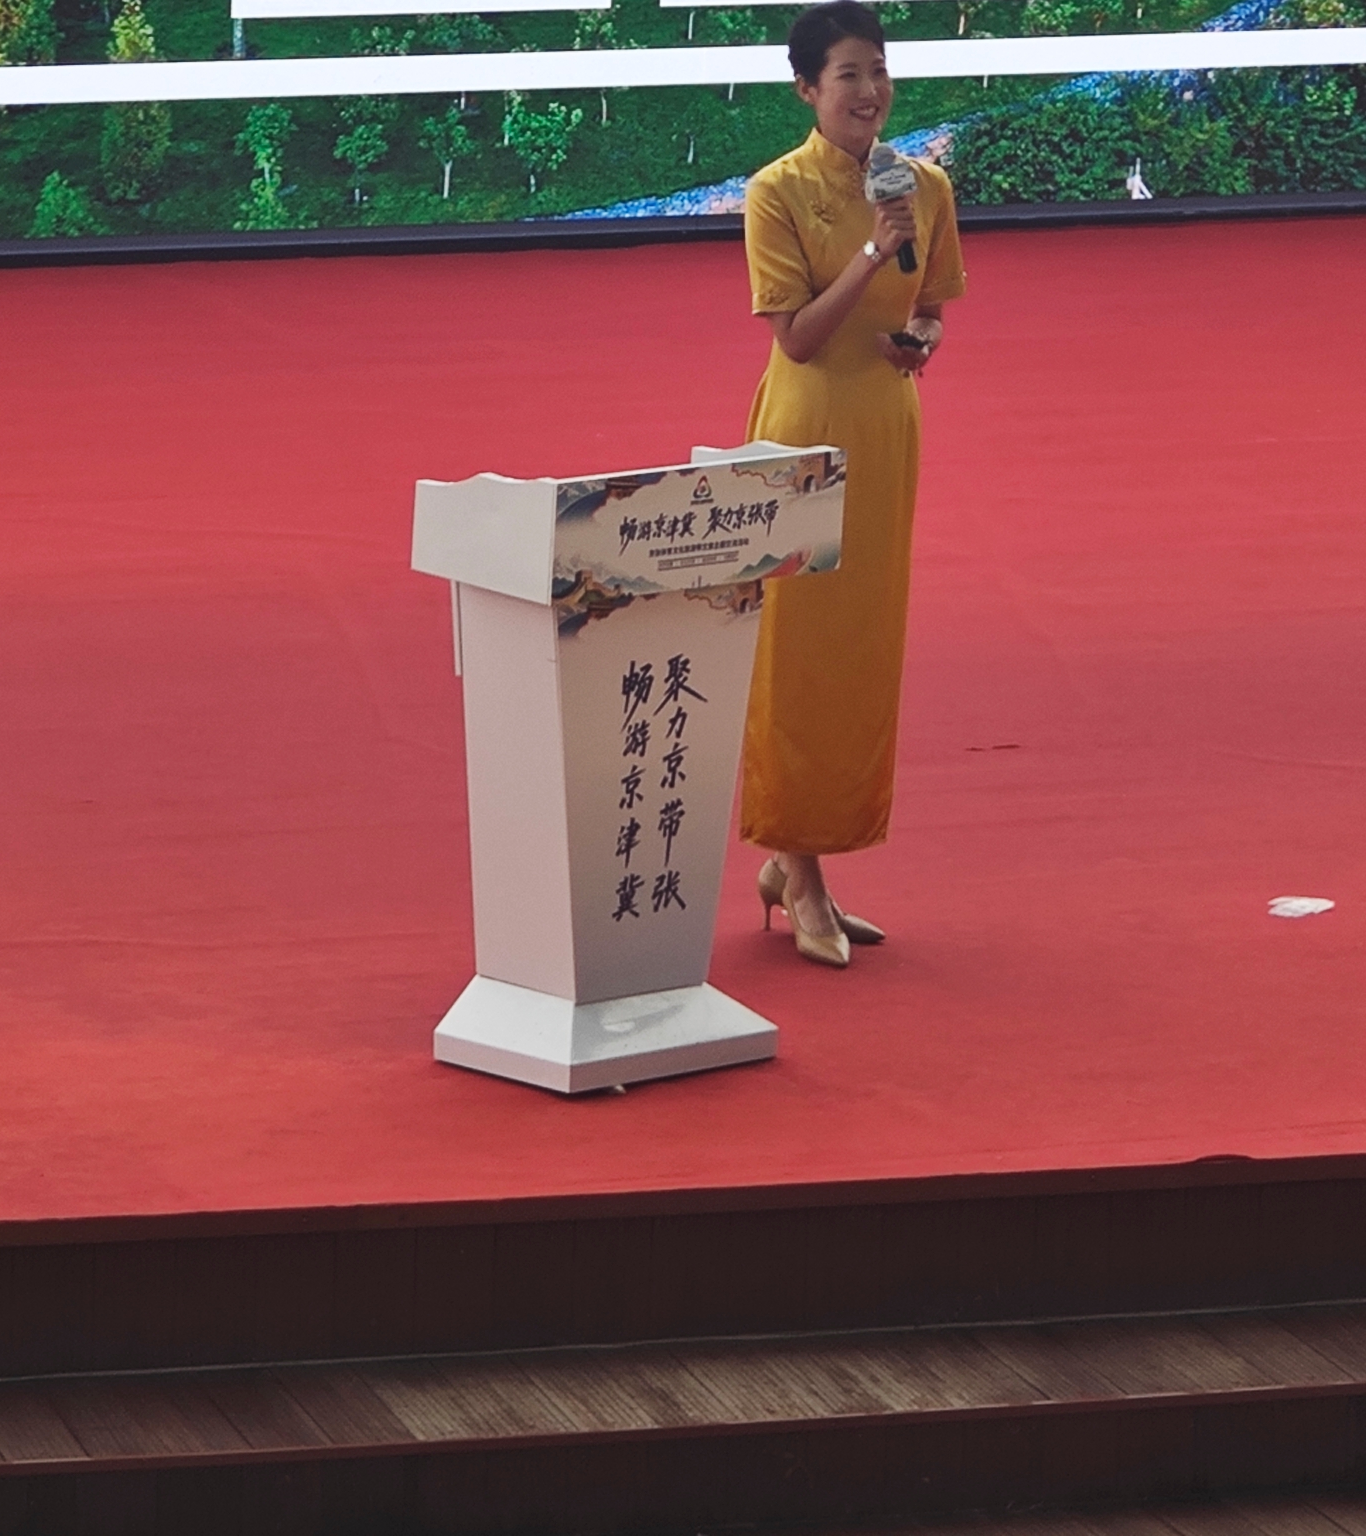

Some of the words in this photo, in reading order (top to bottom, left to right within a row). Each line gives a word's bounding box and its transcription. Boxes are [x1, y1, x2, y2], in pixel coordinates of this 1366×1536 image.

[612, 660, 654, 922] 畅游京津冀
[651, 653, 708, 913] 聚力京带张
